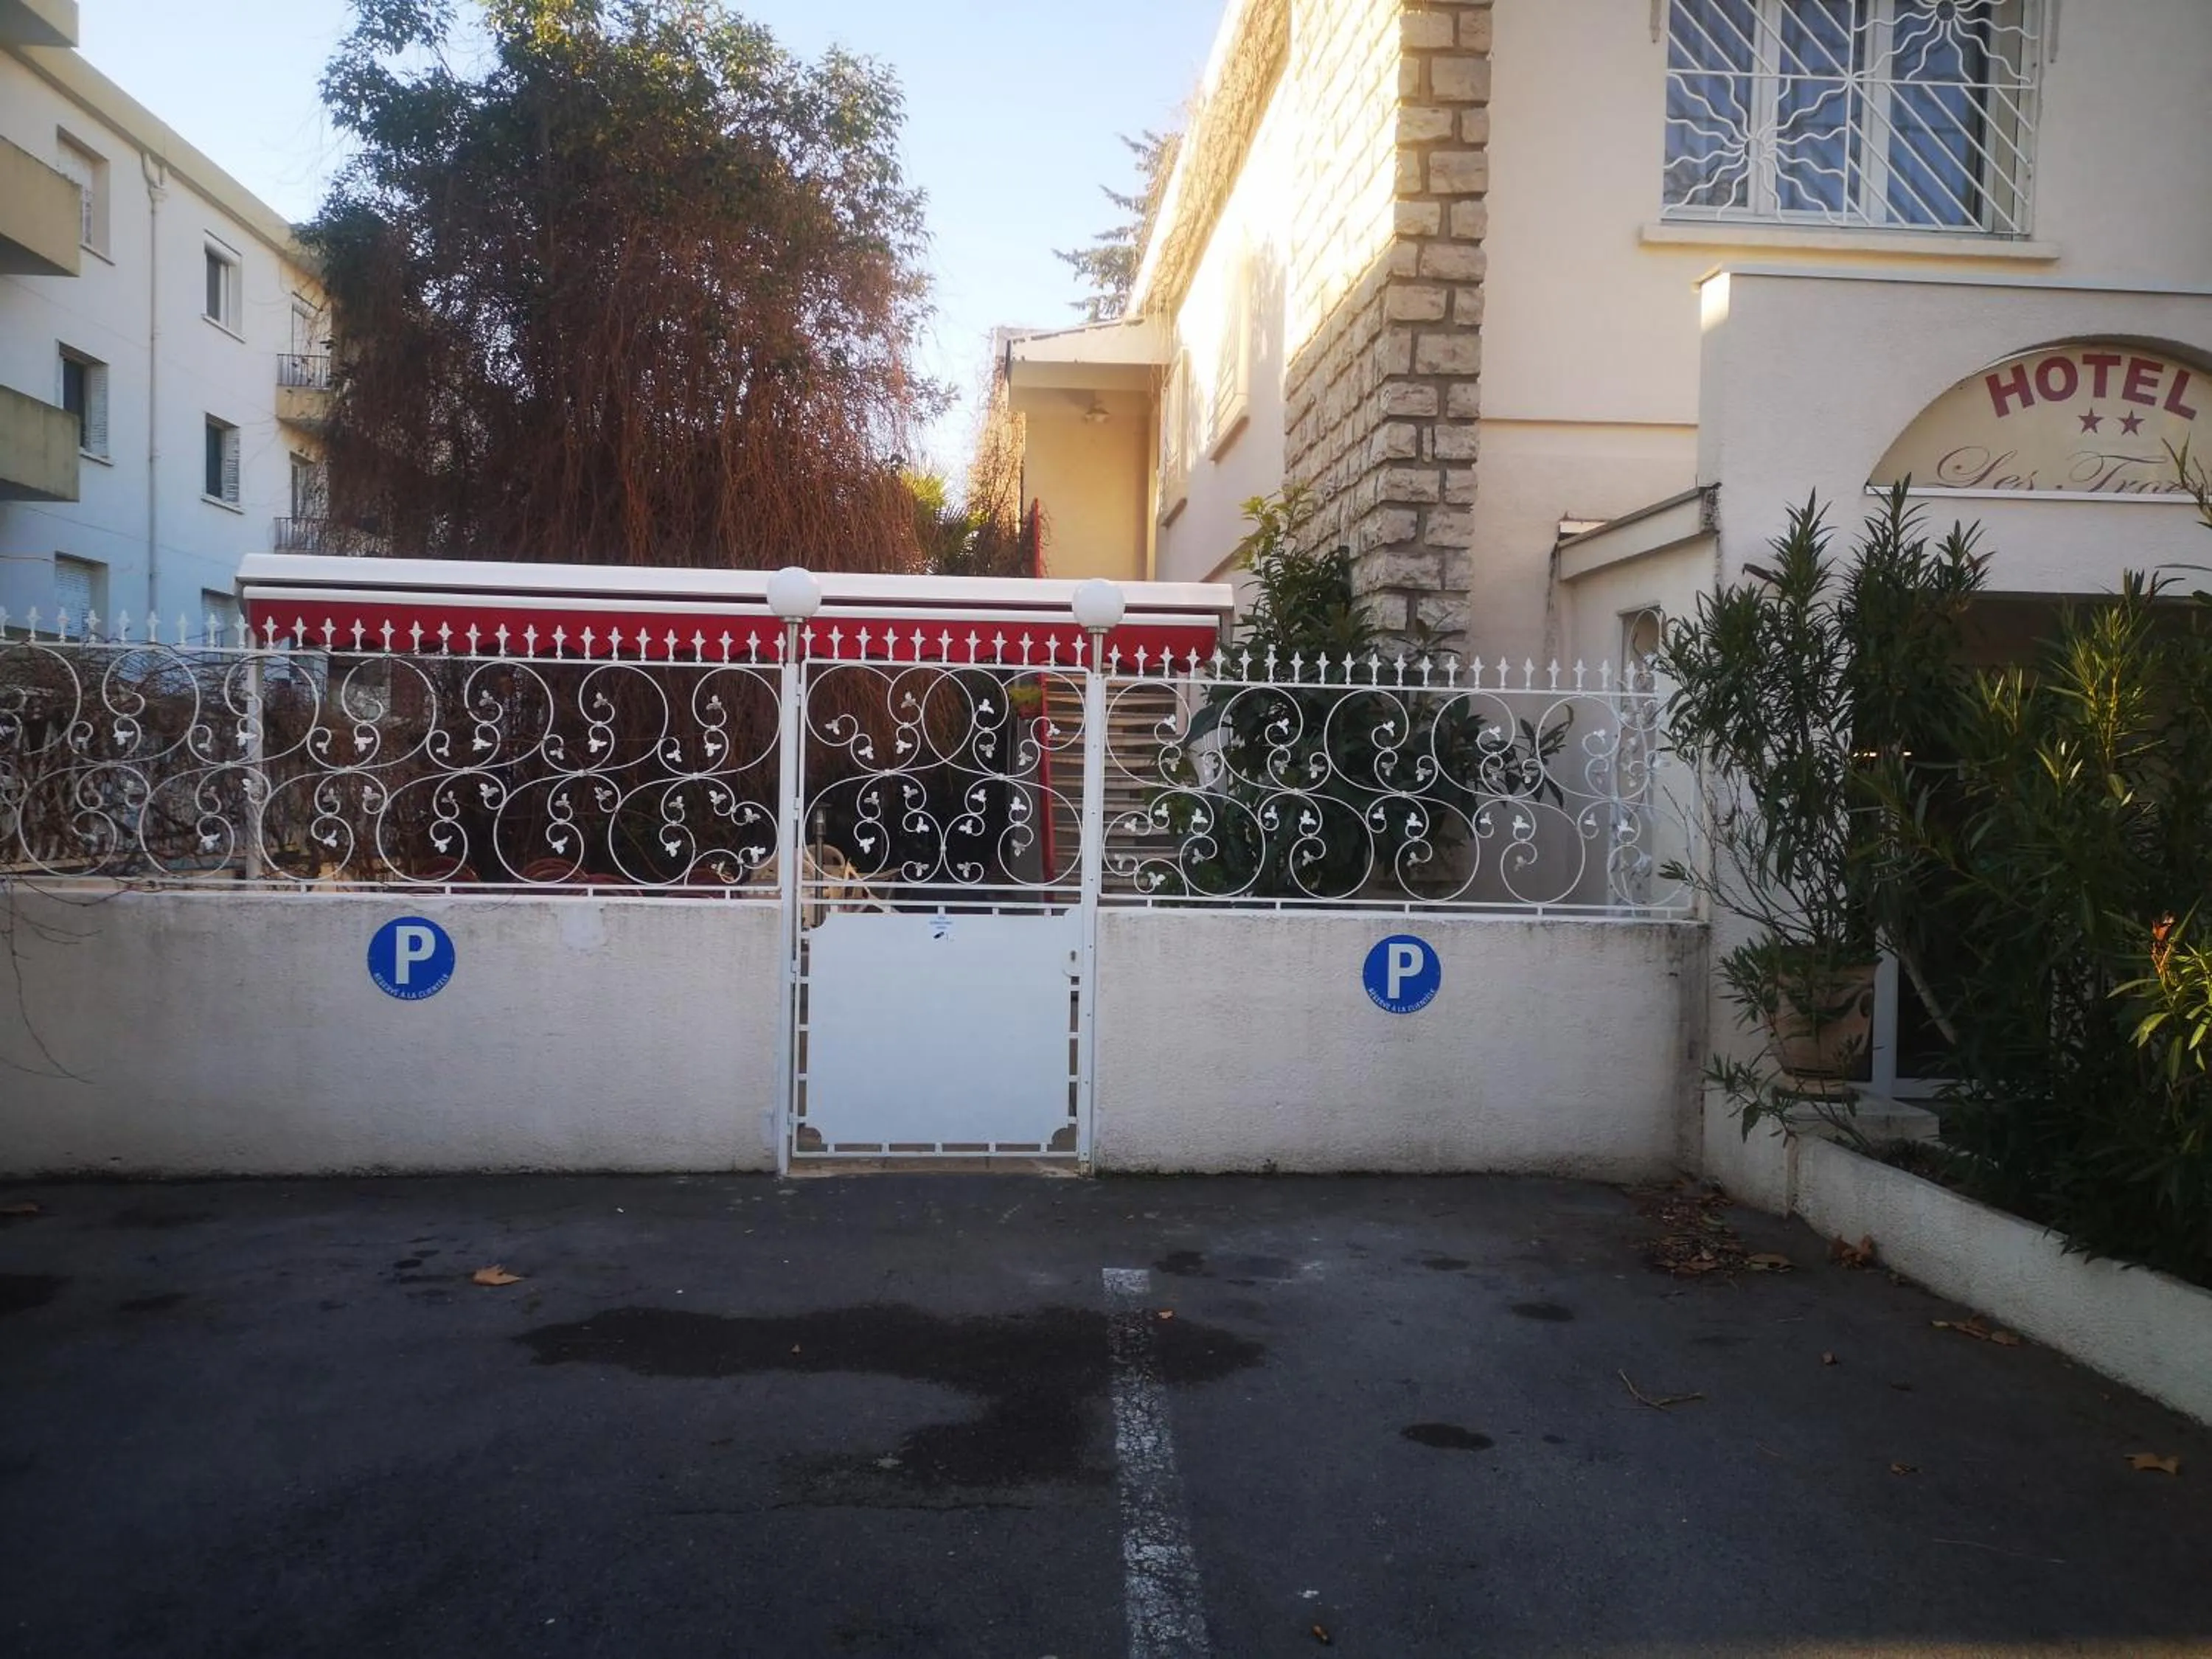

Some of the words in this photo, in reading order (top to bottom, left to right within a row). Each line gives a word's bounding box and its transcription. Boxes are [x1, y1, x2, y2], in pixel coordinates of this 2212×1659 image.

[1985, 353, 2197, 421] HOTEL
[395, 925, 436, 984] P
[1388, 943, 1424, 999] P
